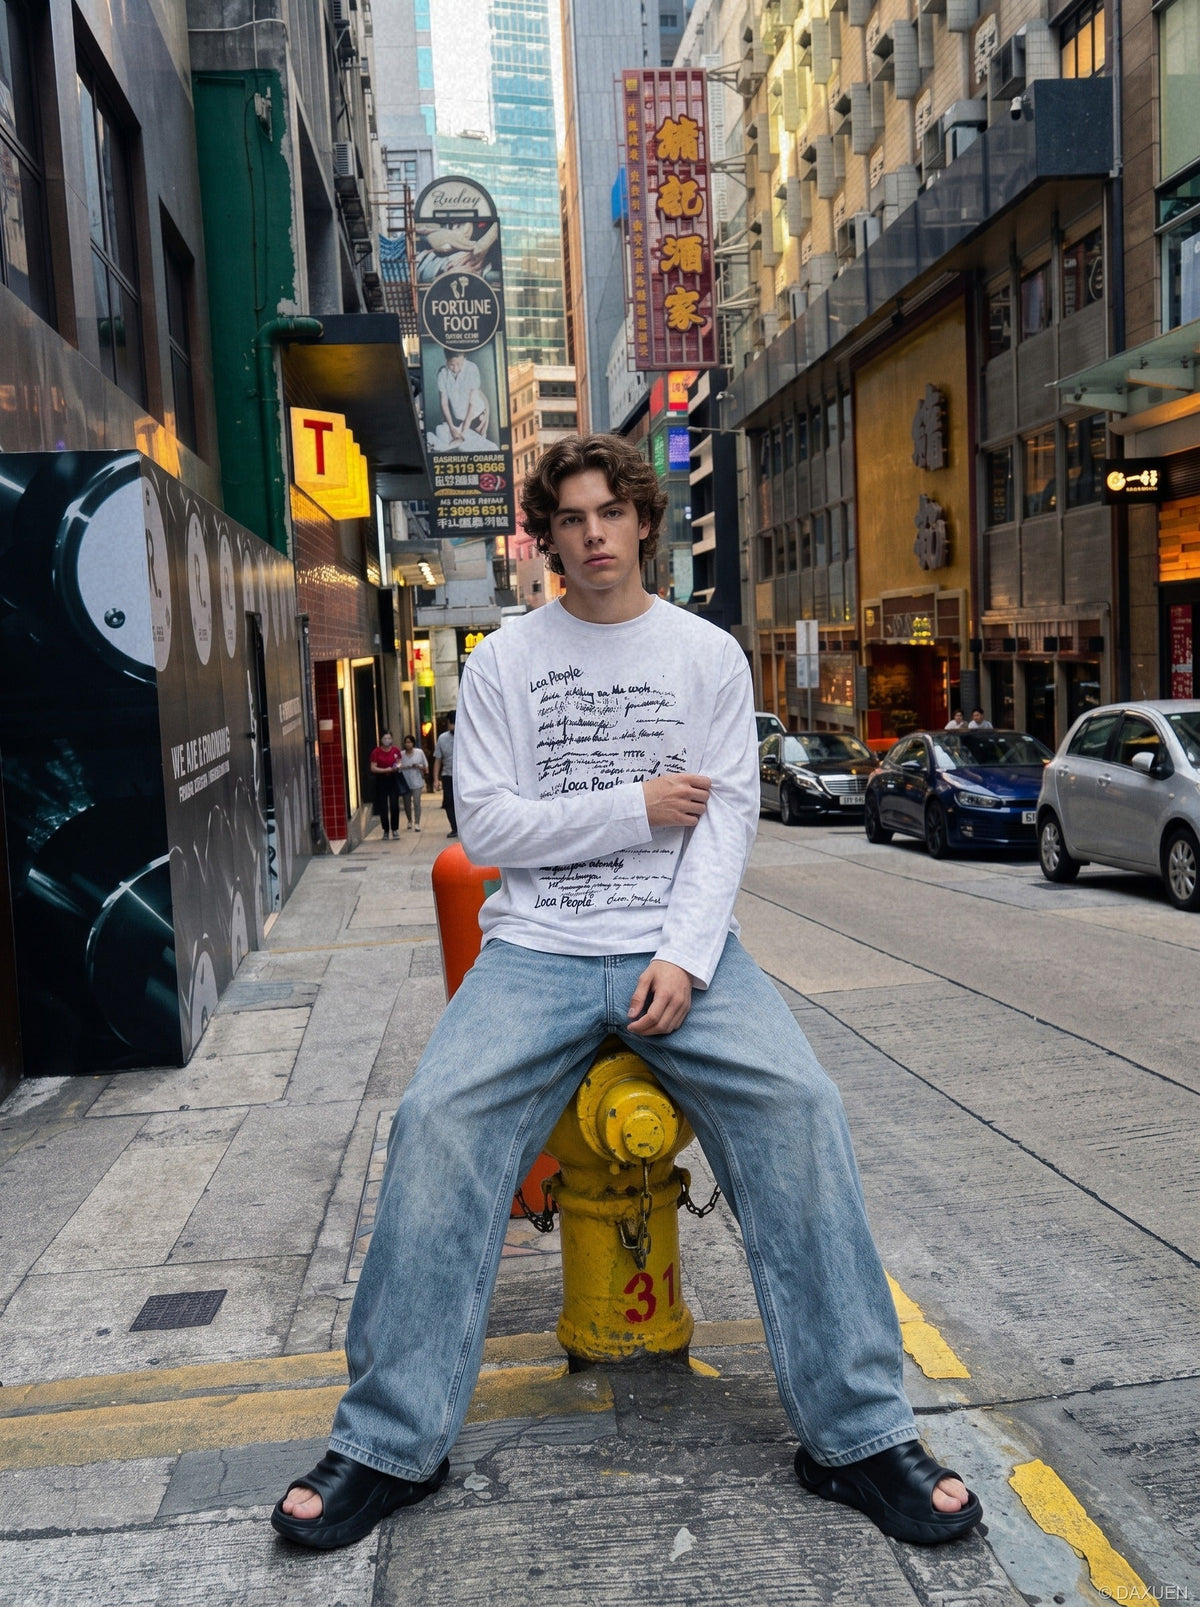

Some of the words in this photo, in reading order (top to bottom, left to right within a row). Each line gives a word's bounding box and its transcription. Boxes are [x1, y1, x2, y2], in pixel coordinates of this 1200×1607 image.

[432, 299, 492, 316] FORTUNE
[443, 315, 480, 332] FOOT
[303, 419, 334, 476] T
[171, 744, 187, 780] WE
[561, 778, 588, 793] Loca
[535, 895, 557, 908] Loca
[624, 1262, 675, 1323] 31
